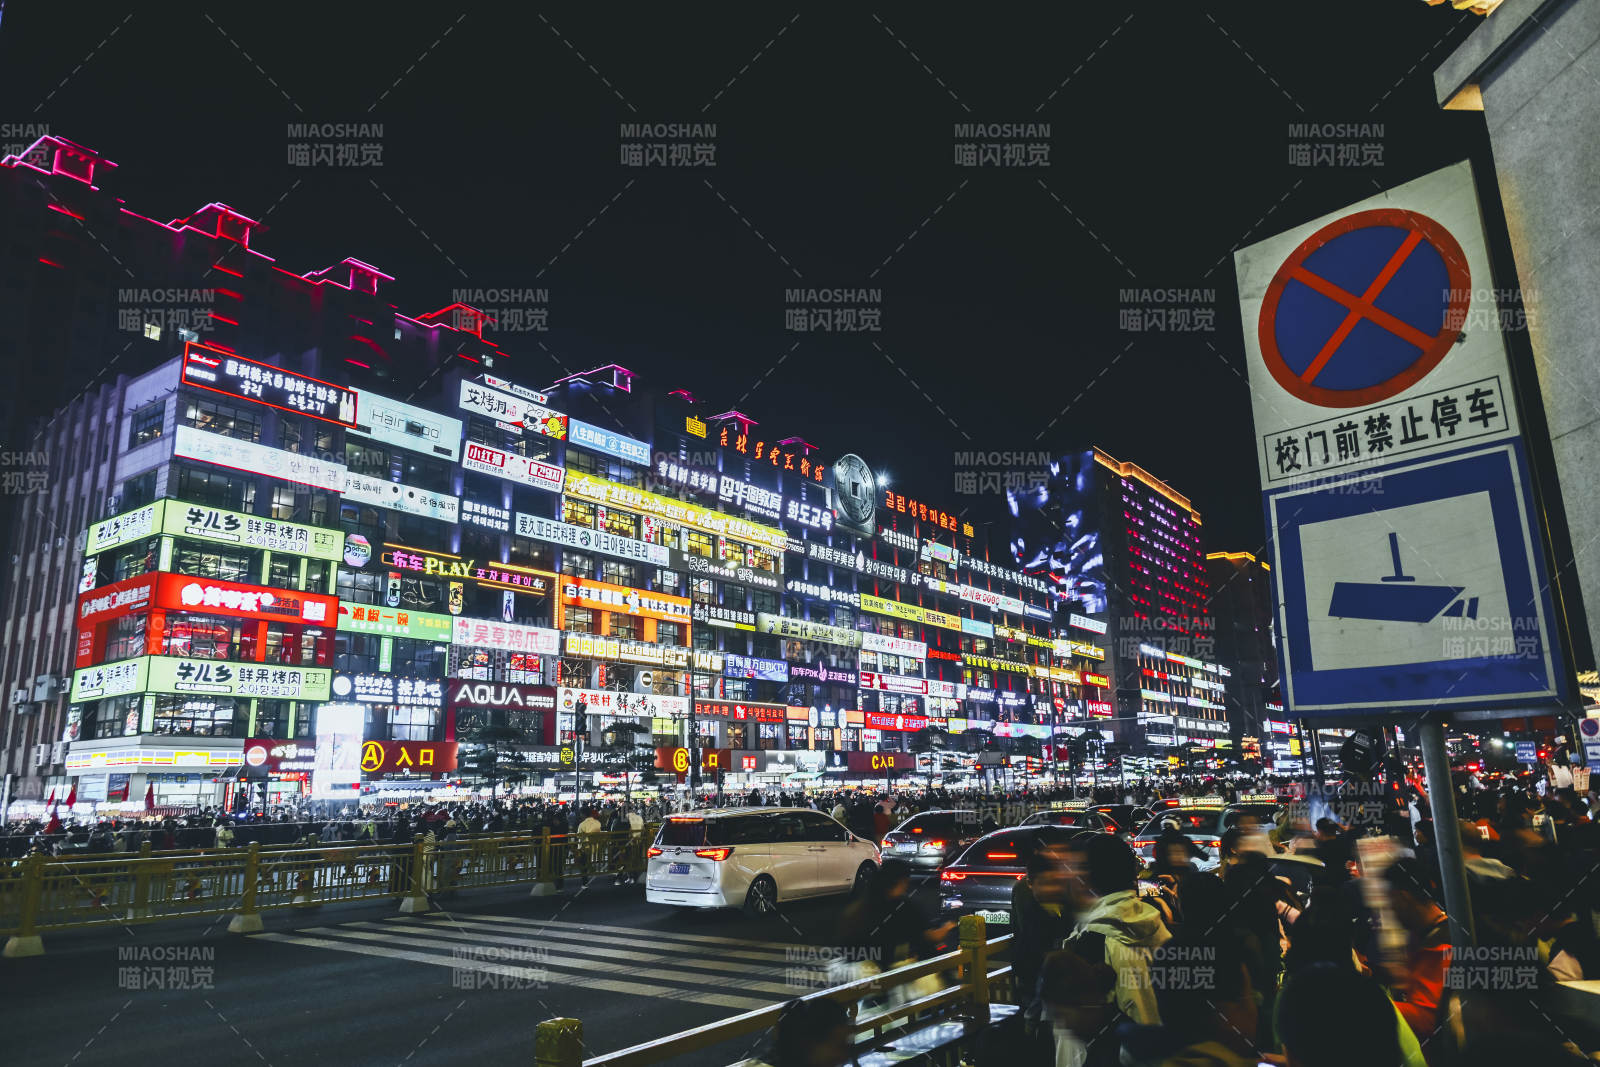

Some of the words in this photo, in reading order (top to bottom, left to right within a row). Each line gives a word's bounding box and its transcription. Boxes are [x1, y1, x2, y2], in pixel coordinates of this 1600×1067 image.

[372, 409, 404, 428] Hair
[1275, 388, 1499, 474] 校门前禁止停车
[187, 507, 241, 532] 牛儿乡
[247, 519, 308, 541] 鲜果烤肉
[911, 572, 922, 586] 6F
[176, 662, 233, 683] 牛儿乡
[238, 667, 301, 686] 鲜果烤肉
[454, 683, 523, 706] AQUA
[395, 746, 434, 767] 入口
